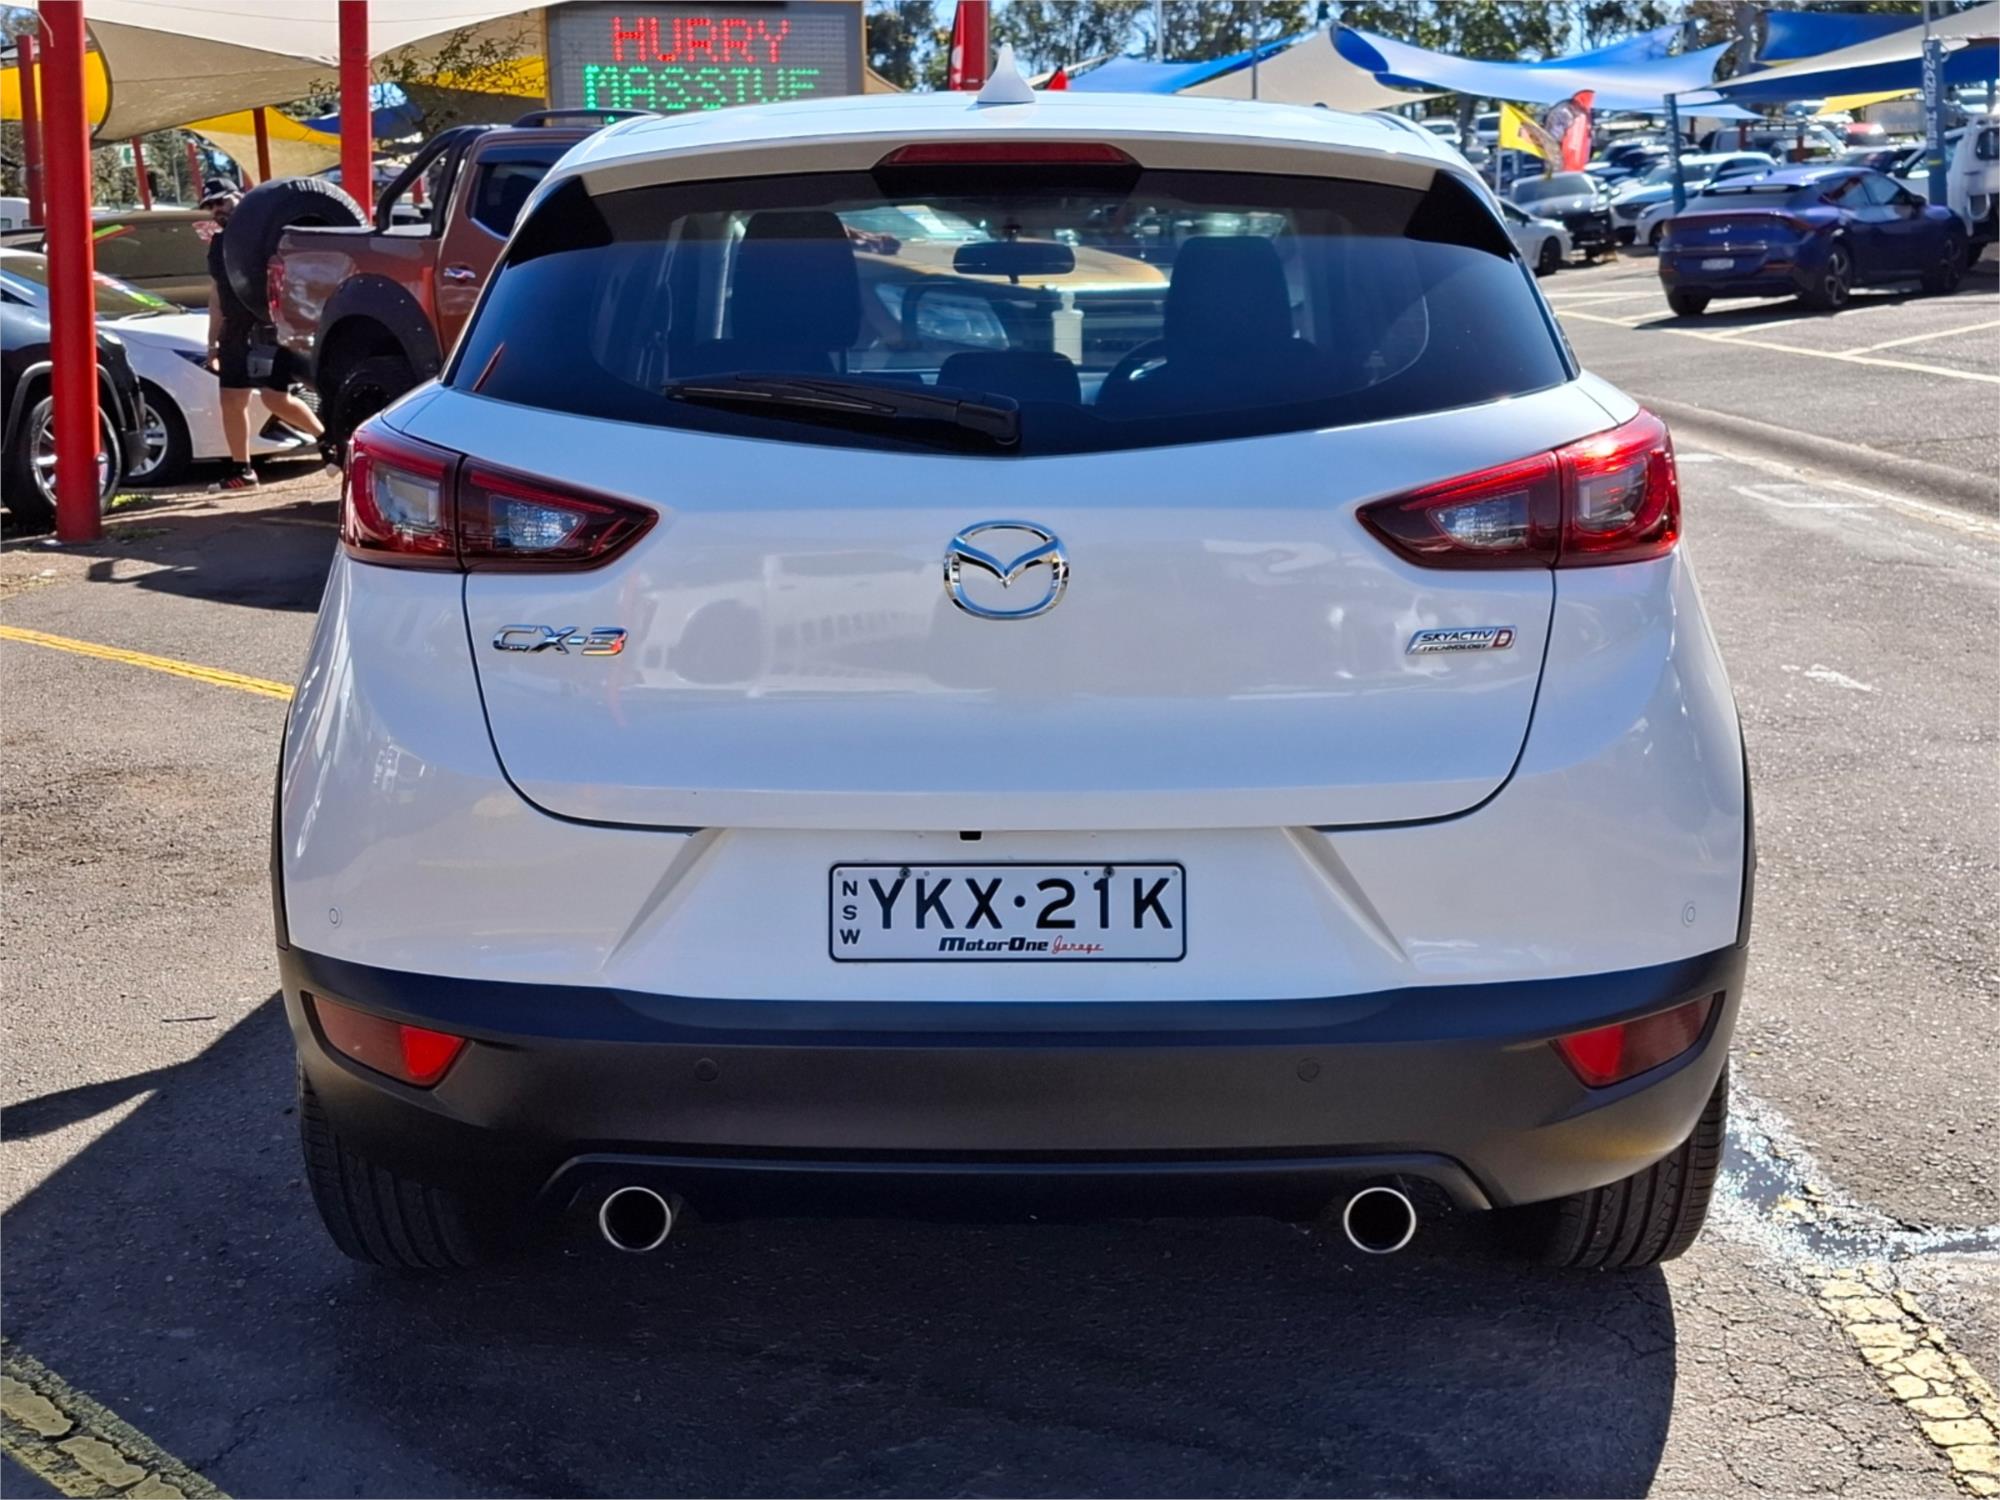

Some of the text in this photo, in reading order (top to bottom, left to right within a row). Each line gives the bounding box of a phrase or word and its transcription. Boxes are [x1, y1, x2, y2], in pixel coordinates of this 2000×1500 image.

[612, 16, 791, 63] HURRY
[585, 64, 820, 110] MASSIVE
[493, 624, 628, 656] CX-3
[1420, 629, 1513, 648] SKYACTIV D
[1421, 643, 1487, 652] TECHNOLOGY
